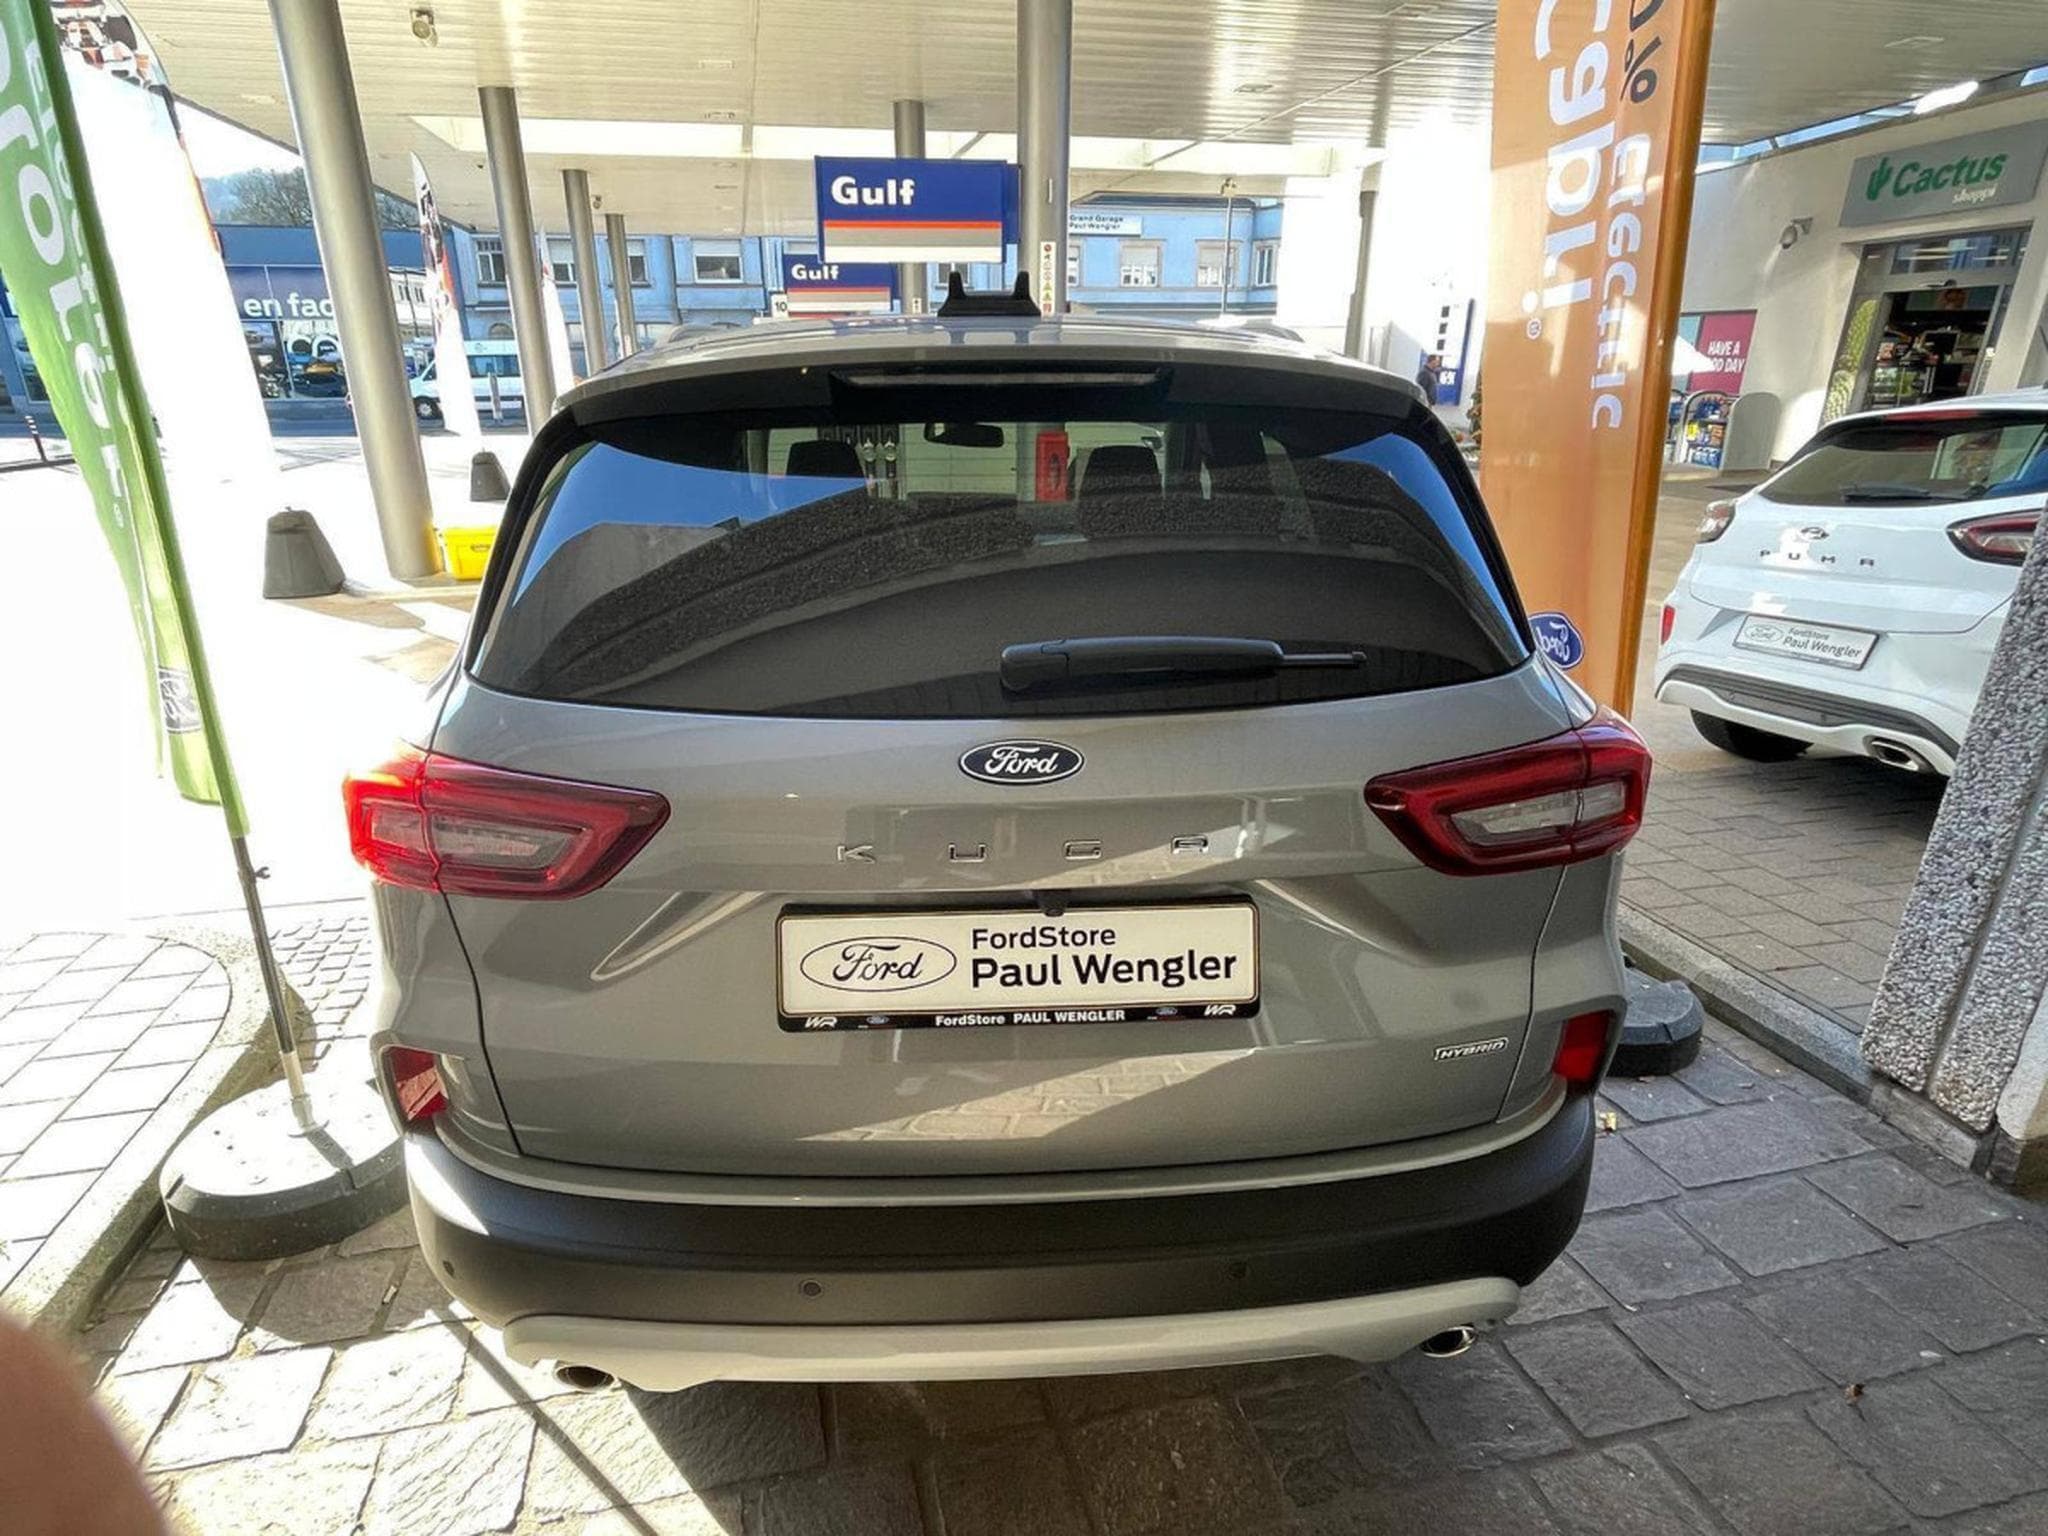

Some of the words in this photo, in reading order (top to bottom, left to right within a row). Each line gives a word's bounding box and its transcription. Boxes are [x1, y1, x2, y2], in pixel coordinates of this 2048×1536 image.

[1892, 153, 2009, 197] Cactus
[831, 175, 916, 206] Gulf
[791, 263, 839, 281] Gulf
[243, 297, 287, 318] en
[774, 301, 787, 312] 10
[1707, 340, 1733, 356] HAVE
[1733, 341, 1741, 356] A
[1724, 357, 1745, 373] DAY
[1760, 550, 1875, 567] PUMA
[1782, 636, 1809, 650] Paul
[1811, 639, 1863, 658] Wengler
[836, 834, 1209, 864] KUGA
[972, 926, 1117, 950] FordStore
[832, 943, 924, 982] Ford
[971, 953, 1062, 989] Paul
[1071, 949, 1237, 989] Wengler
[935, 1013, 1006, 1027] FordStore
[1013, 1012, 1051, 1024] PAUL
[1054, 1009, 1126, 1023] WENGLER
[1440, 1041, 1505, 1059] HYBRID
